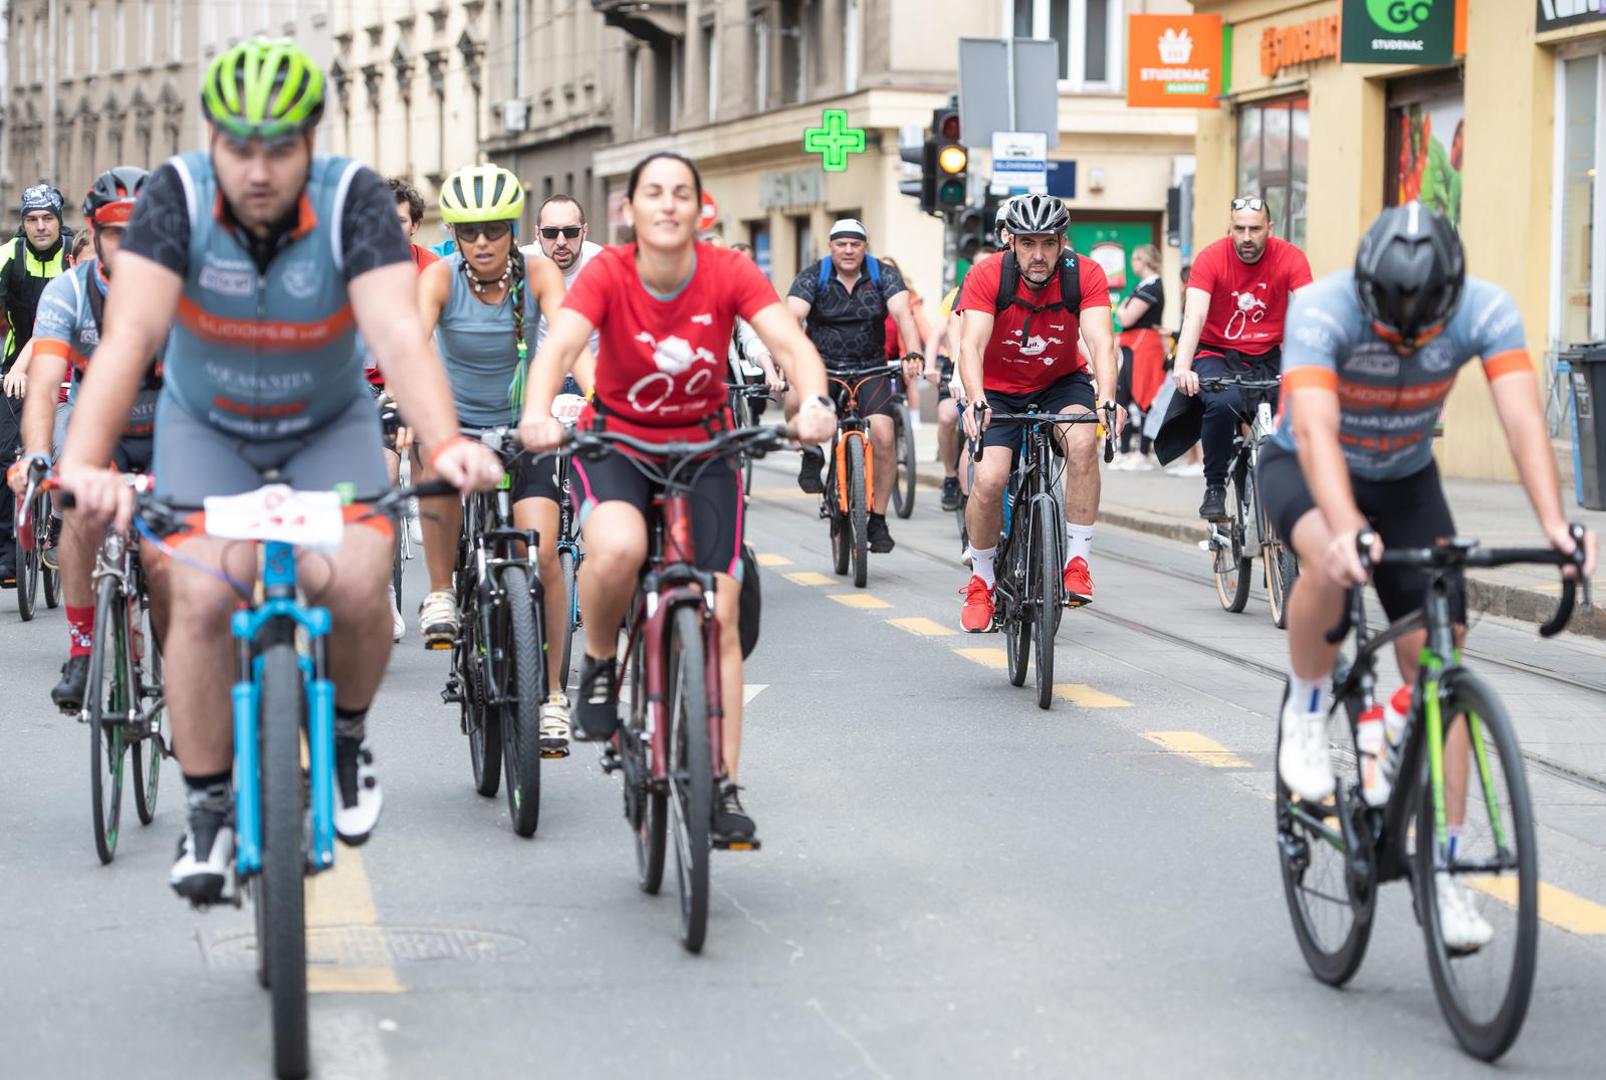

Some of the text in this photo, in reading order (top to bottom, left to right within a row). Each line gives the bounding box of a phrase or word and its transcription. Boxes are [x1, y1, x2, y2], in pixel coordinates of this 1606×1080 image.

[1388, 2, 1429, 24] GO
[1371, 39, 1424, 50] STUDENAC
[1140, 68, 1210, 81] STUDENAC
